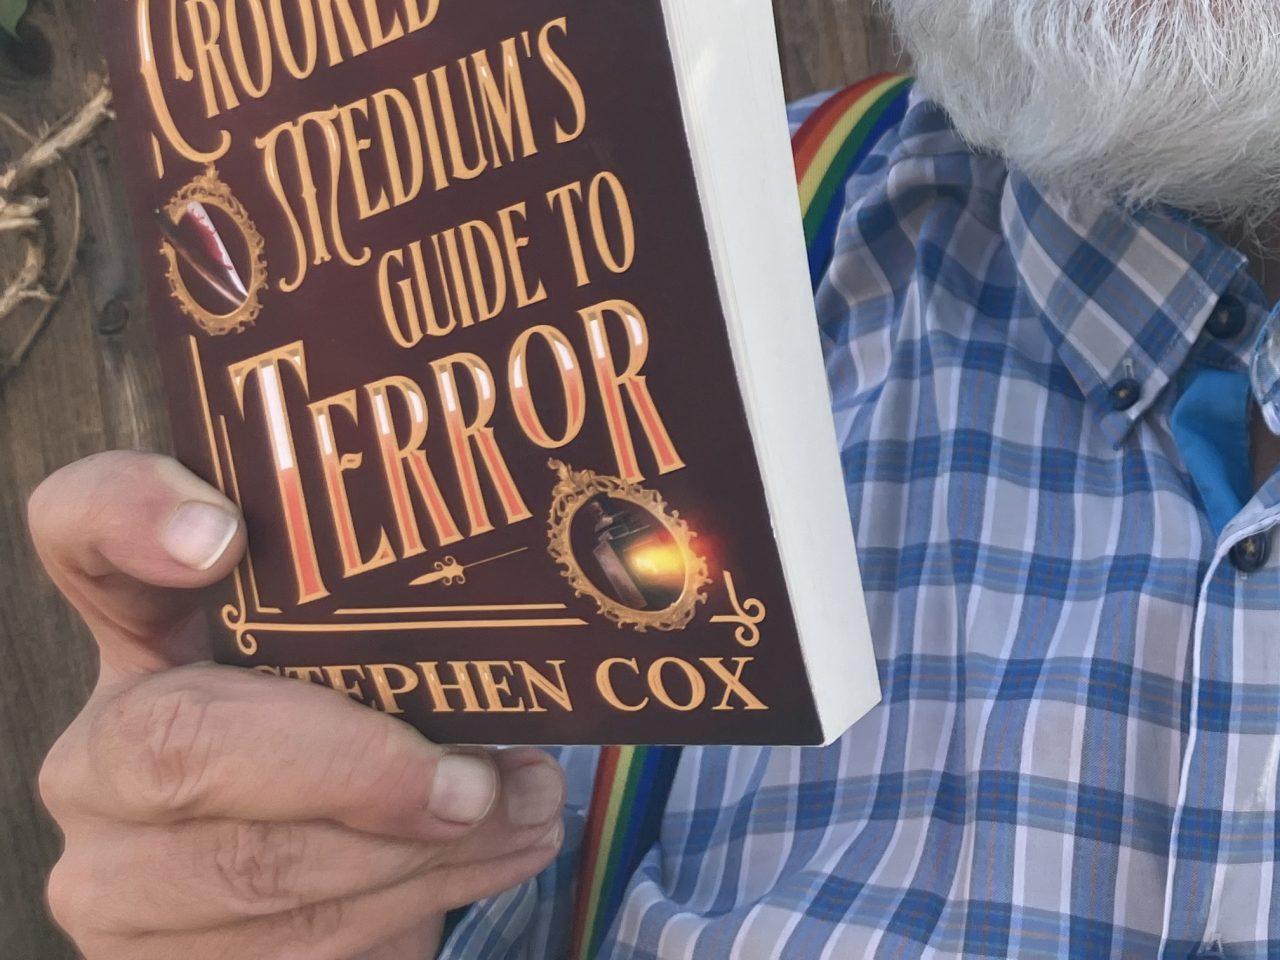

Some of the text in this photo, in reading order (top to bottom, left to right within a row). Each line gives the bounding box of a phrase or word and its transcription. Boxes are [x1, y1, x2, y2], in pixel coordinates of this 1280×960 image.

[254, 16, 587, 294] MEDIUM'S
[377, 170, 637, 349] GUIDE TO
[228, 298, 688, 606] TERROR
[252, 656, 770, 714] EPHEN COX
